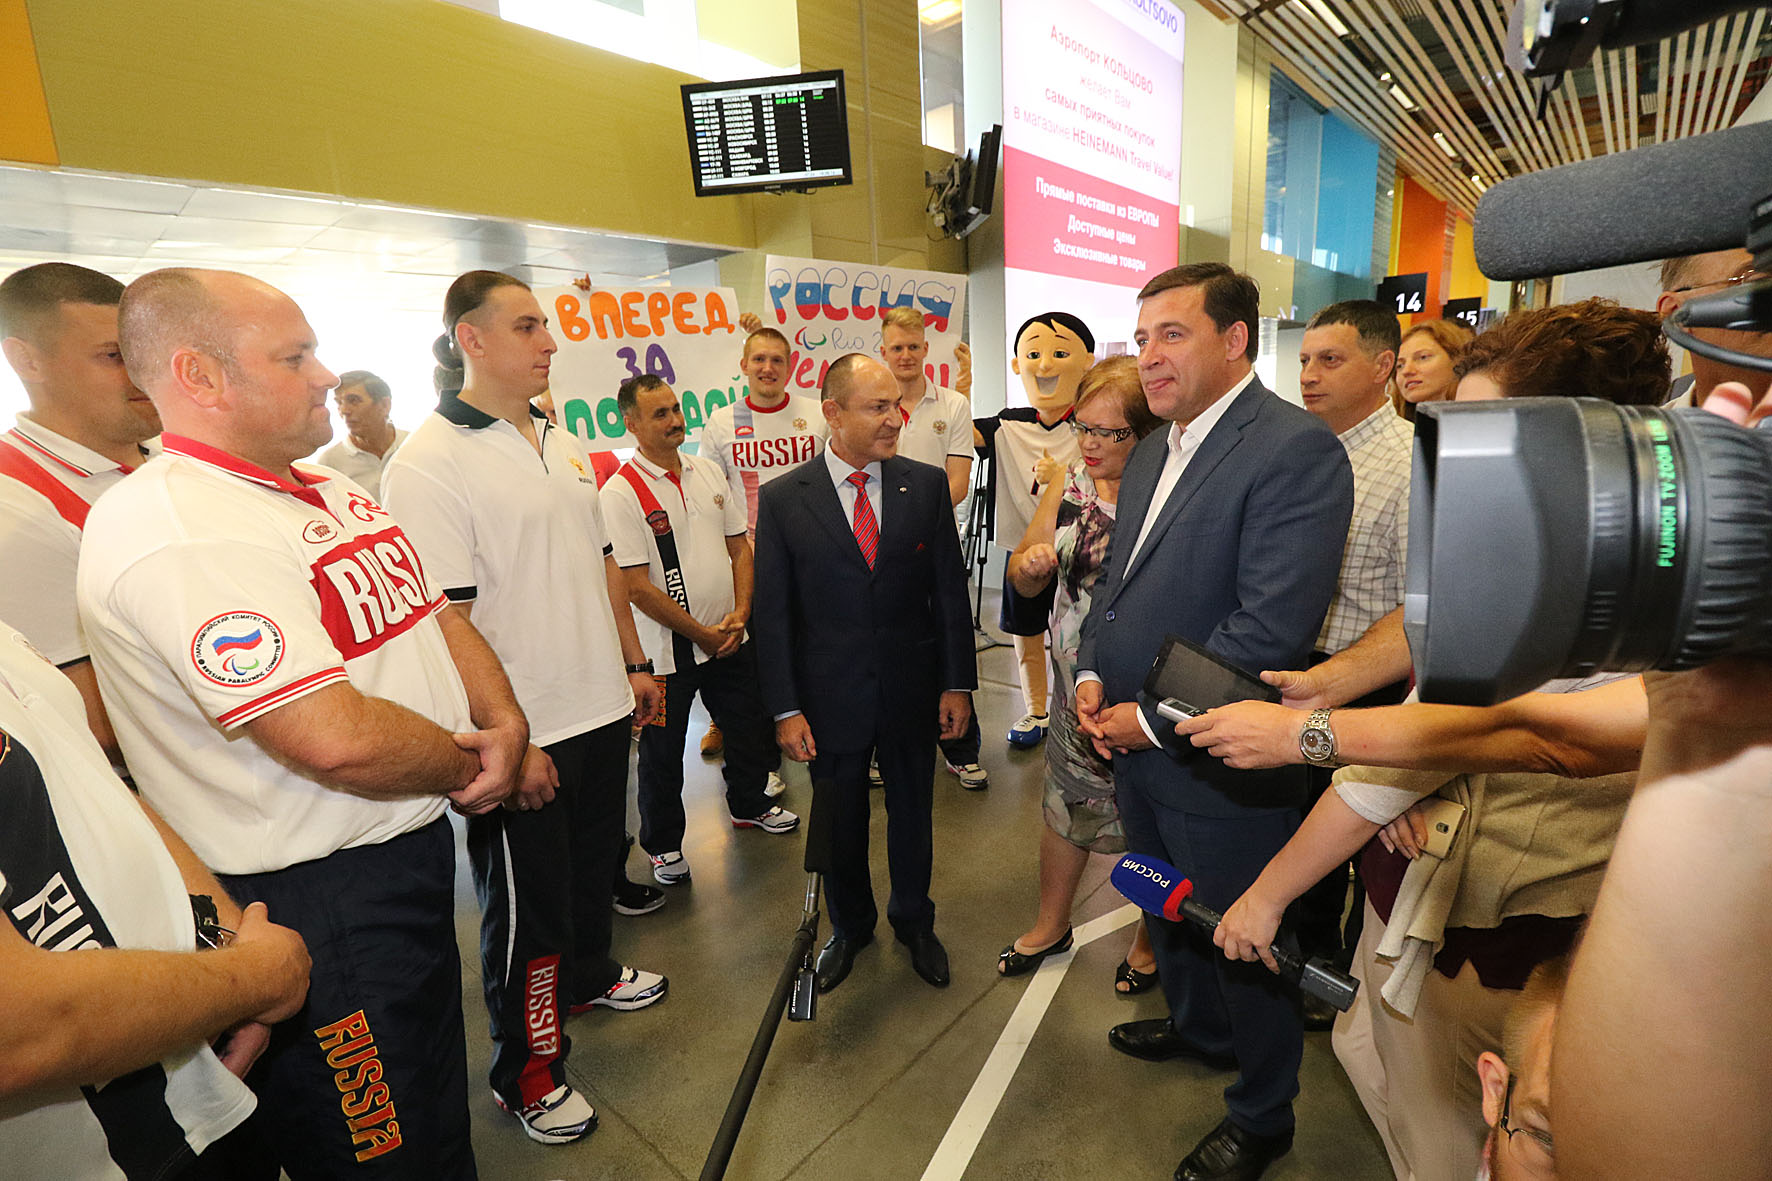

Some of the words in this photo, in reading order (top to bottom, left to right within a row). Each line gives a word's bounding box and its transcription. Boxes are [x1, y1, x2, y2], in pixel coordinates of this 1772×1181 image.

[1050, 25, 1101, 65] Аэропорт
[1103, 55, 1154, 95] КОЛЬЦОВО
[1045, 87, 1078, 113] самых
[1079, 102, 1123, 134] приятных
[1124, 124, 1156, 149] покупок
[1072, 130, 1128, 163] HEINEMANN
[1035, 176, 1075, 204] Прямые
[1076, 192, 1116, 216] поставки
[1116, 203, 1127, 218] из
[1127, 205, 1160, 229] ЕВРОПЫ
[1053, 238, 1118, 266] Эксклюзивные
[1119, 254, 1147, 273] товары
[1067, 214, 1115, 241] Доступные
[1116, 228, 1137, 246] цены
[555, 291, 735, 342] ВПЕРЕД
[768, 267, 956, 333] РОССИЯ
[1395, 291, 1422, 313] 14
[616, 343, 676, 386] ЗА
[732, 435, 816, 469] RUSSIA
[1656, 505, 1677, 568] FUJINON
[1121, 858, 1172, 889] РОССИЯ
[528, 964, 558, 1056] RUSSIA
[314, 1009, 403, 1163] RUSSIA
